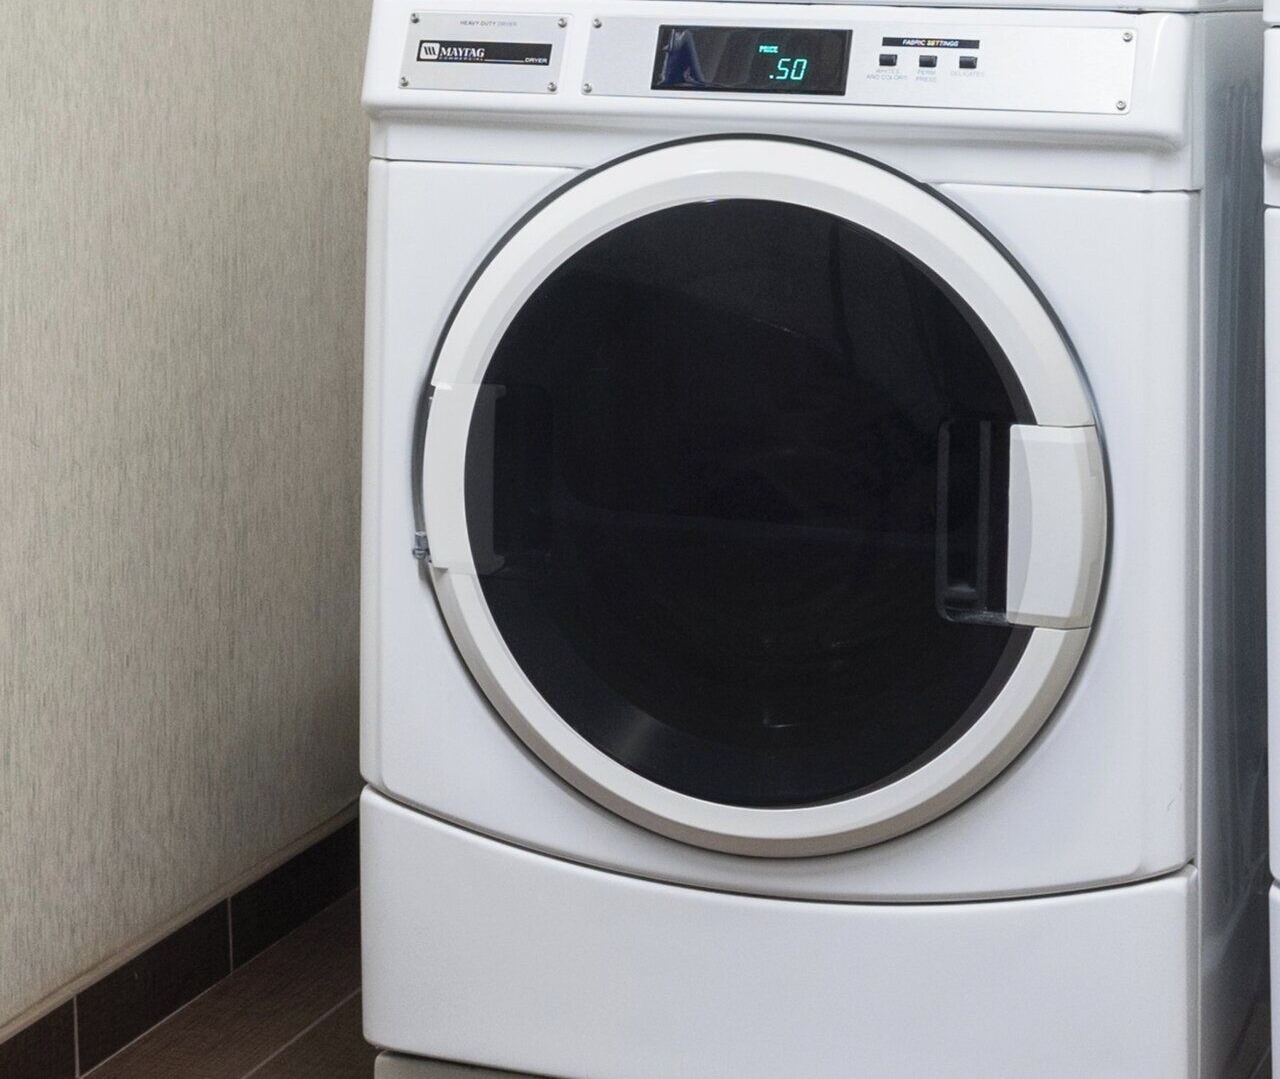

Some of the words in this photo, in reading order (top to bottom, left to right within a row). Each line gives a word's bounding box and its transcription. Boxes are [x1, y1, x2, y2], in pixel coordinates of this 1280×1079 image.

[926, 39, 960, 47] SETTINGS
[440, 47, 485, 58] MAYTAG
[759, 45, 779, 53] PRICE
[769, 58, 808, 80] .50
